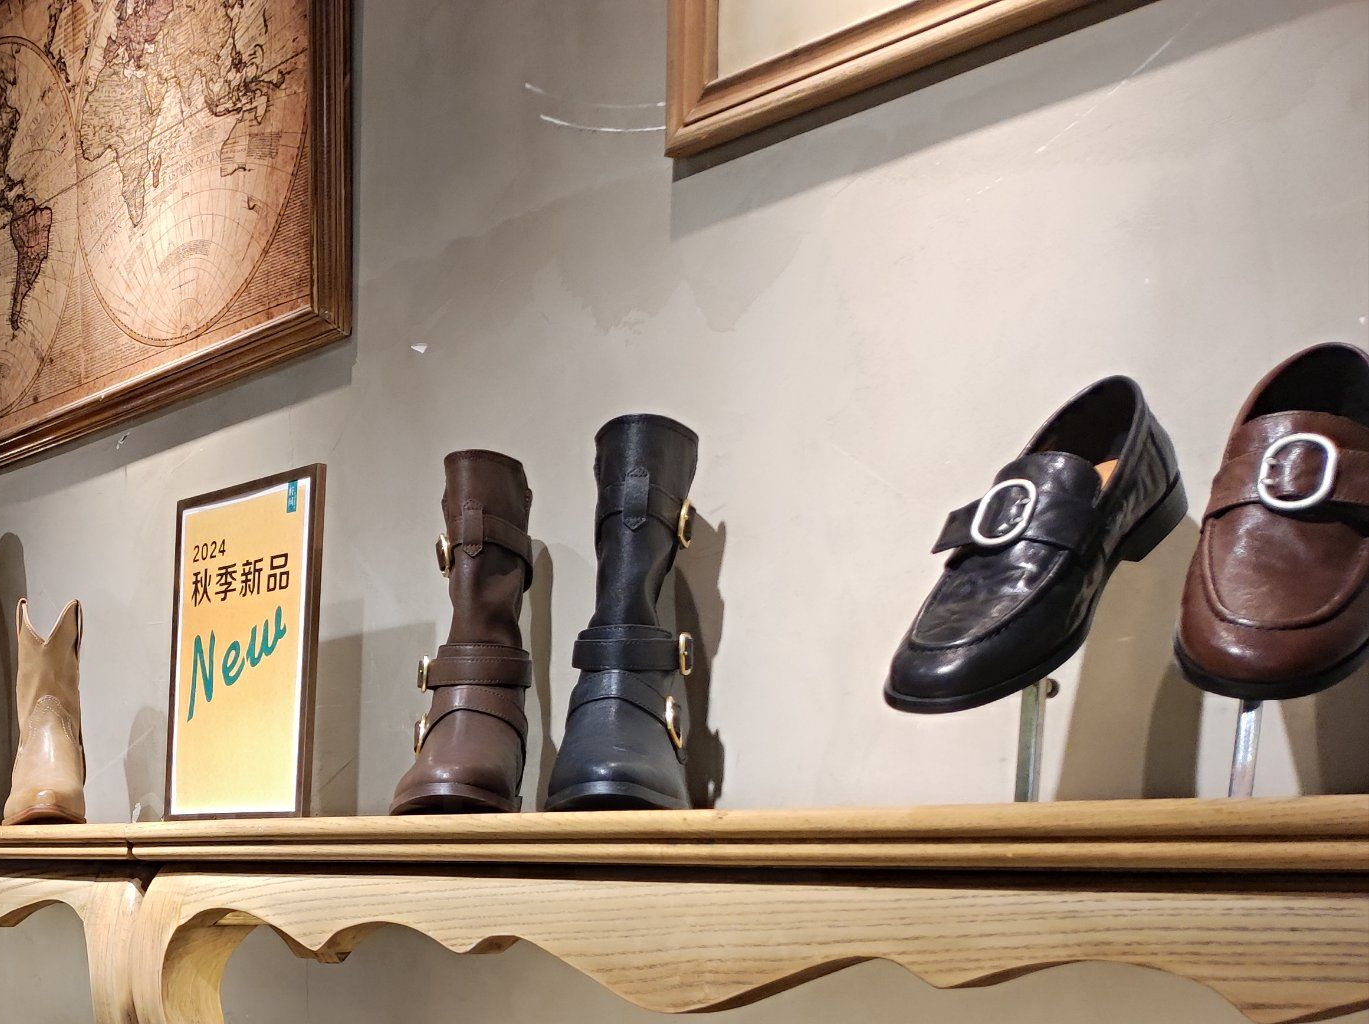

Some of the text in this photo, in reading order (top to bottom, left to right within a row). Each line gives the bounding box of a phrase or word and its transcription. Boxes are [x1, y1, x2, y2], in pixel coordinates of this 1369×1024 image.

[192, 538, 226, 563] 2024
[191, 552, 290, 607] 秋季新品
[186, 605, 288, 723] New
